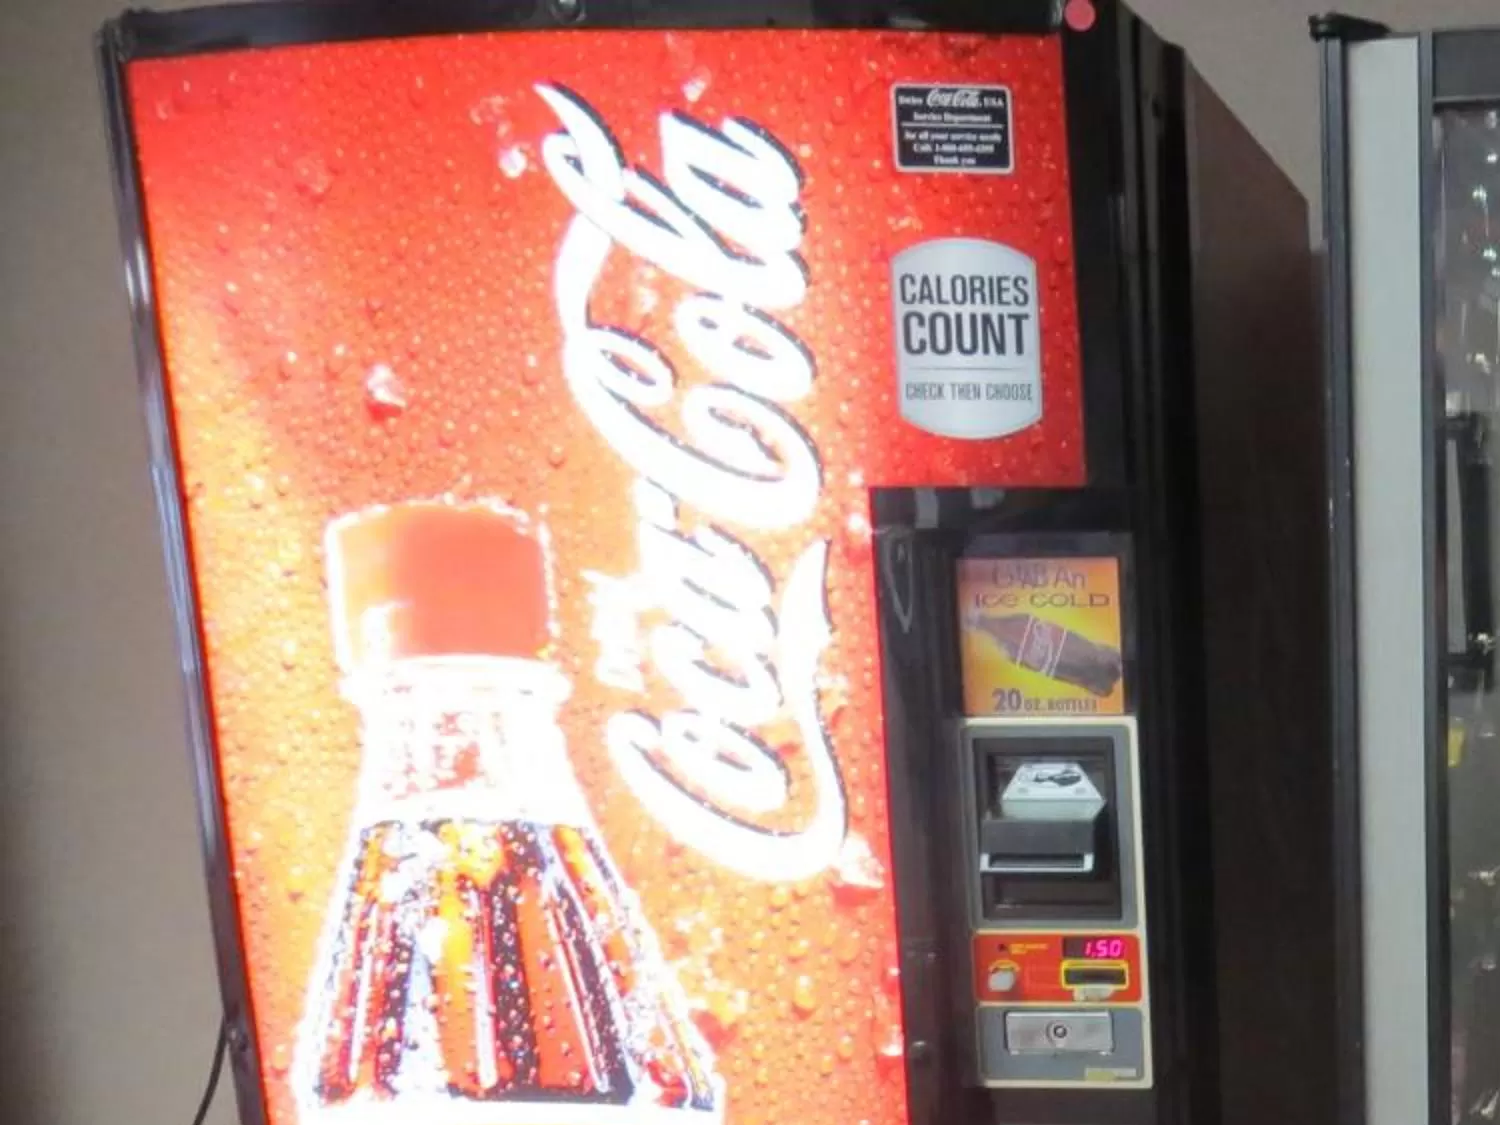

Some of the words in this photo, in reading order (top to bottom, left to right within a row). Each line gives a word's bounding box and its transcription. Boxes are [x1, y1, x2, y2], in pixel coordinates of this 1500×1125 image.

[900, 273, 1030, 307] CALORIES
[902, 312, 1031, 356] COUNT
[904, 381, 945, 402] CHECK
[949, 381, 982, 402] THEN
[985, 381, 1034, 402] CHOOSE
[536, 82, 850, 880] Coca-Cola
[1030, 592, 1110, 608] COLD
[991, 687, 1022, 712] 20
[1083, 938, 1123, 958] 1.50
